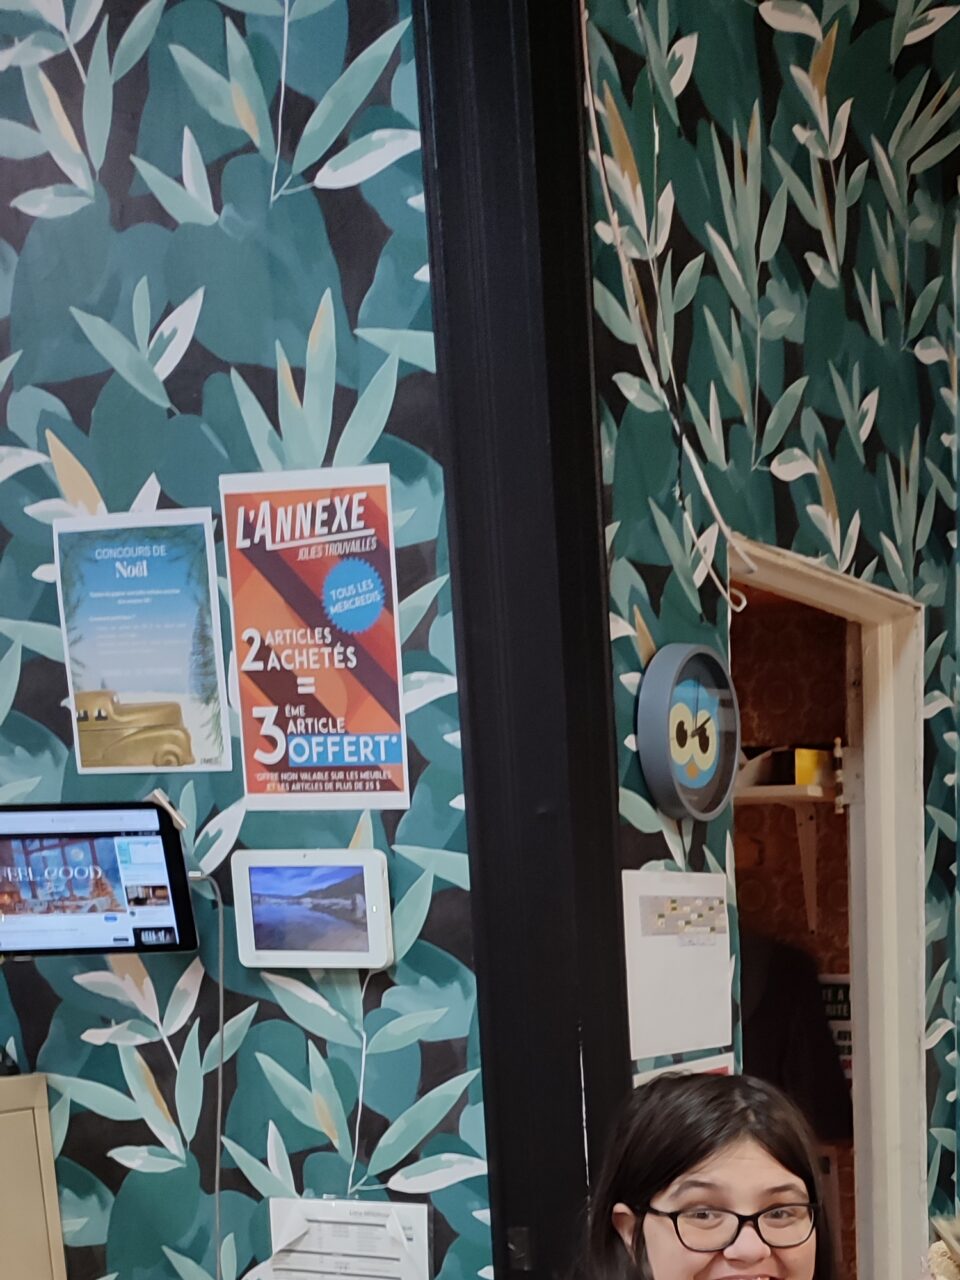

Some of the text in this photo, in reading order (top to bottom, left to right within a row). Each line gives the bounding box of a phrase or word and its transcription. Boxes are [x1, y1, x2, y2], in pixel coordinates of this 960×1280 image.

[236, 491, 369, 551] L'ANNEXE
[95, 545, 167, 559] CONCOURS DE
[297, 536, 377, 561] JOLIES TROUVAILLES
[115, 559, 148, 578] Noël
[330, 578, 374, 601] TOUS LES
[329, 590, 382, 615] MERCREDIS
[264, 626, 332, 647] ARTICLES
[240, 627, 265, 672] 2
[266, 641, 358, 672] ACHETÉS
[252, 705, 287, 765] 3
[287, 717, 346, 735] ARTICLE
[280, 771, 299, 781] NON
[331, 770, 345, 780] SUR
[346, 770, 359, 780] LES
[291, 781, 323, 791] ARTICLES
[335, 781, 353, 791] PLUS
[44, 864, 102, 881] GOOD
